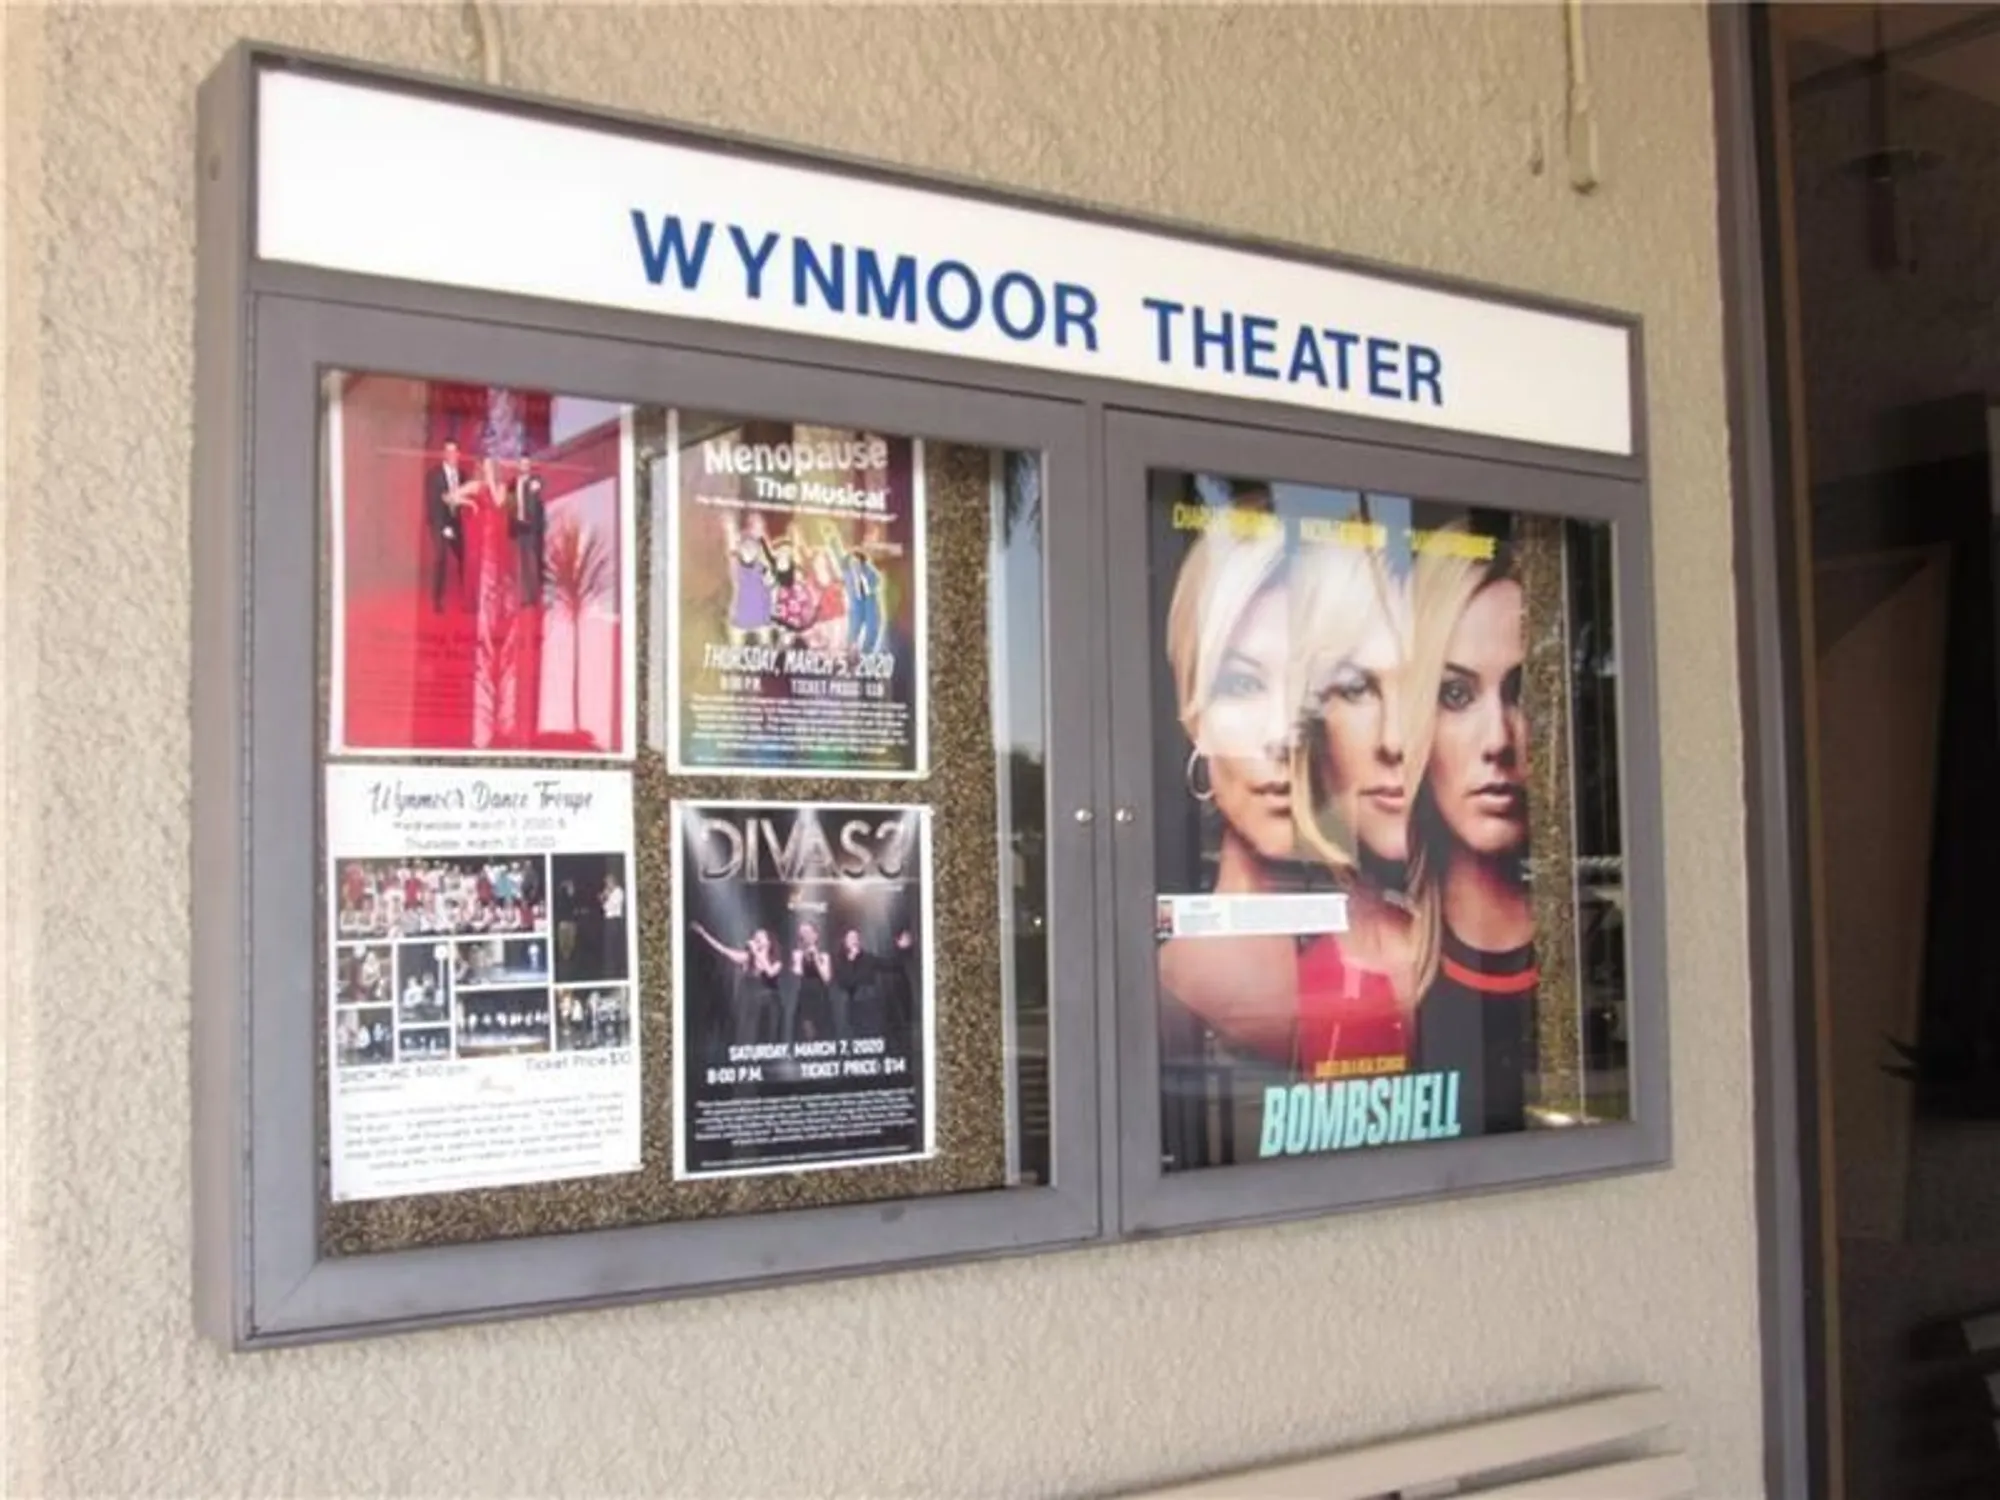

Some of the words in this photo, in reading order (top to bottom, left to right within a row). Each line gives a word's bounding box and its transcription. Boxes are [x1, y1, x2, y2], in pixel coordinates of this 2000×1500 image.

[631, 209, 1098, 351] WYNMOOR
[1143, 297, 1443, 405] THEATER
[703, 437, 889, 475] Menopause
[754, 476, 797, 501] The
[801, 482, 886, 511] Musical
[855, 652, 895, 679] 2020
[525, 1056, 569, 1071] Ticket
[794, 1042, 836, 1058] MARCH
[852, 1038, 886, 1055] 2020
[801, 1061, 841, 1079] TICKET
[1260, 1071, 1461, 1158] BOMBSHELL
